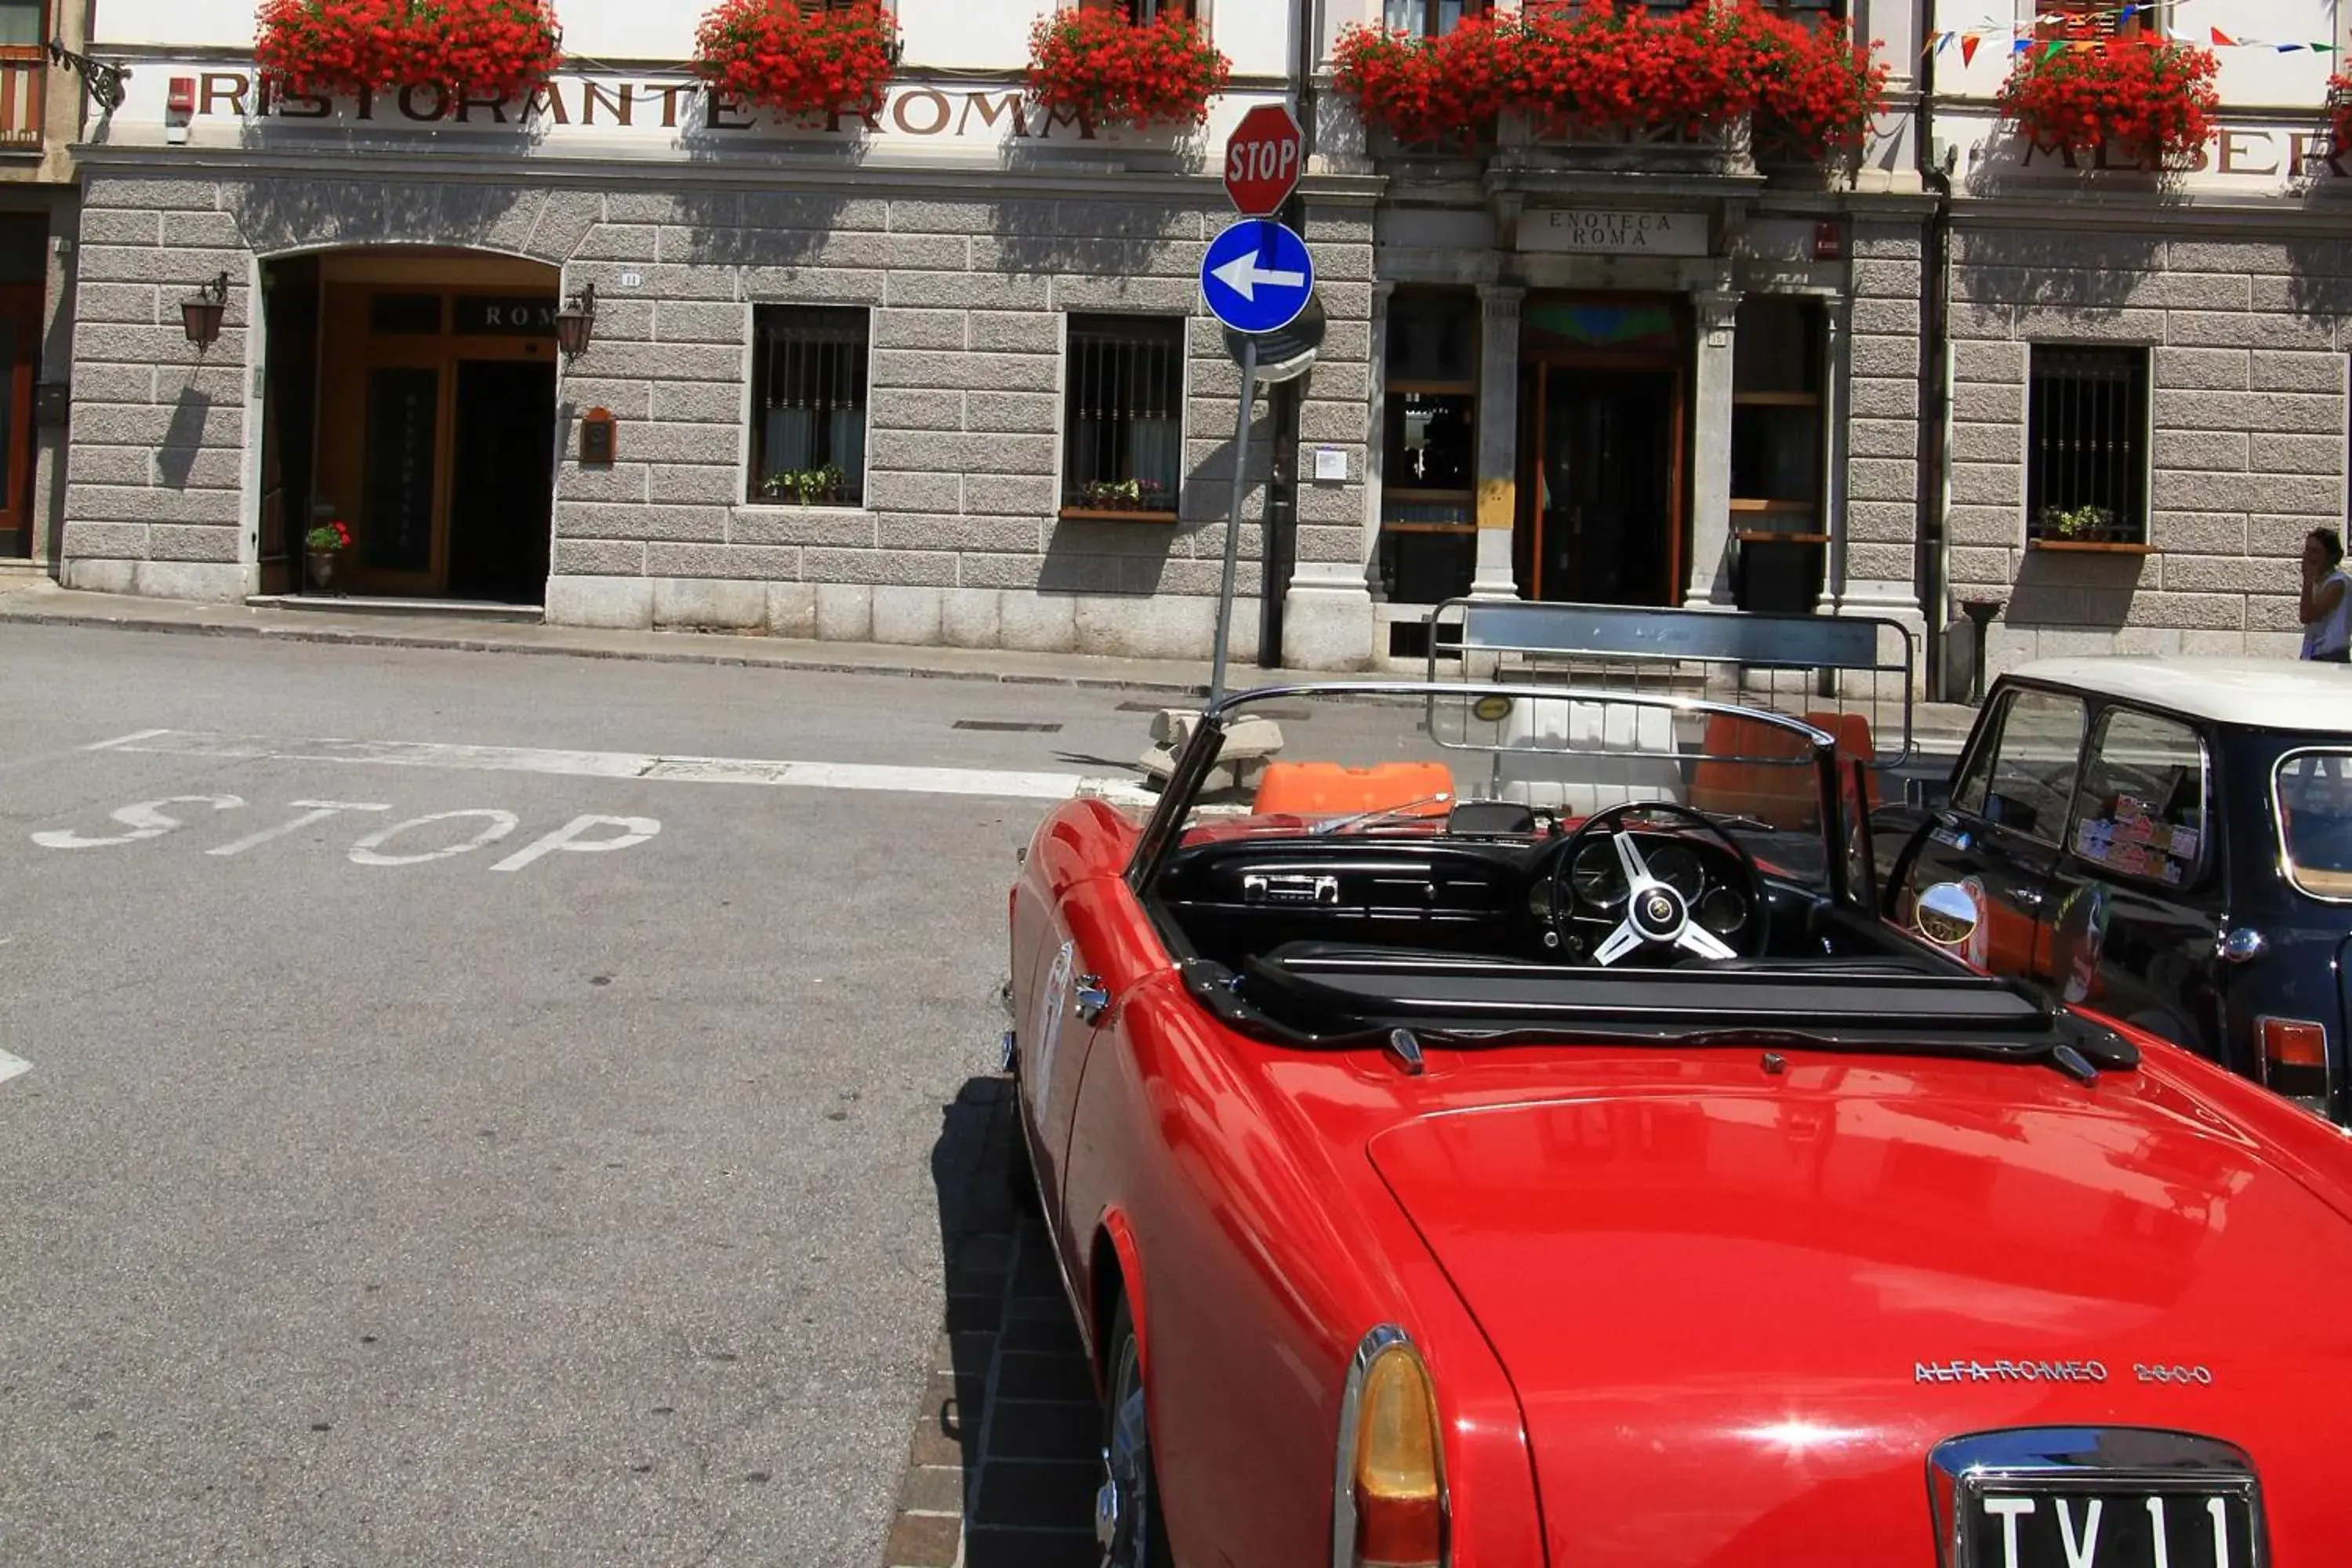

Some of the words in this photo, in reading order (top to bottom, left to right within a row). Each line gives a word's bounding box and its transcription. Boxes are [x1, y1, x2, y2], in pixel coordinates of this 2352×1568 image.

[198, 72, 757, 129] RISTORANTE
[1229, 139, 1297, 182] STOP
[1549, 212, 1671, 230] ENOTECA
[1573, 228, 1647, 246] ROMA
[30, 793, 662, 872] STOP
[1915, 1360, 1991, 1383] ALFA
[1994, 1359, 2108, 1383] ROMEO
[2132, 1363, 2212, 1385] 2600
